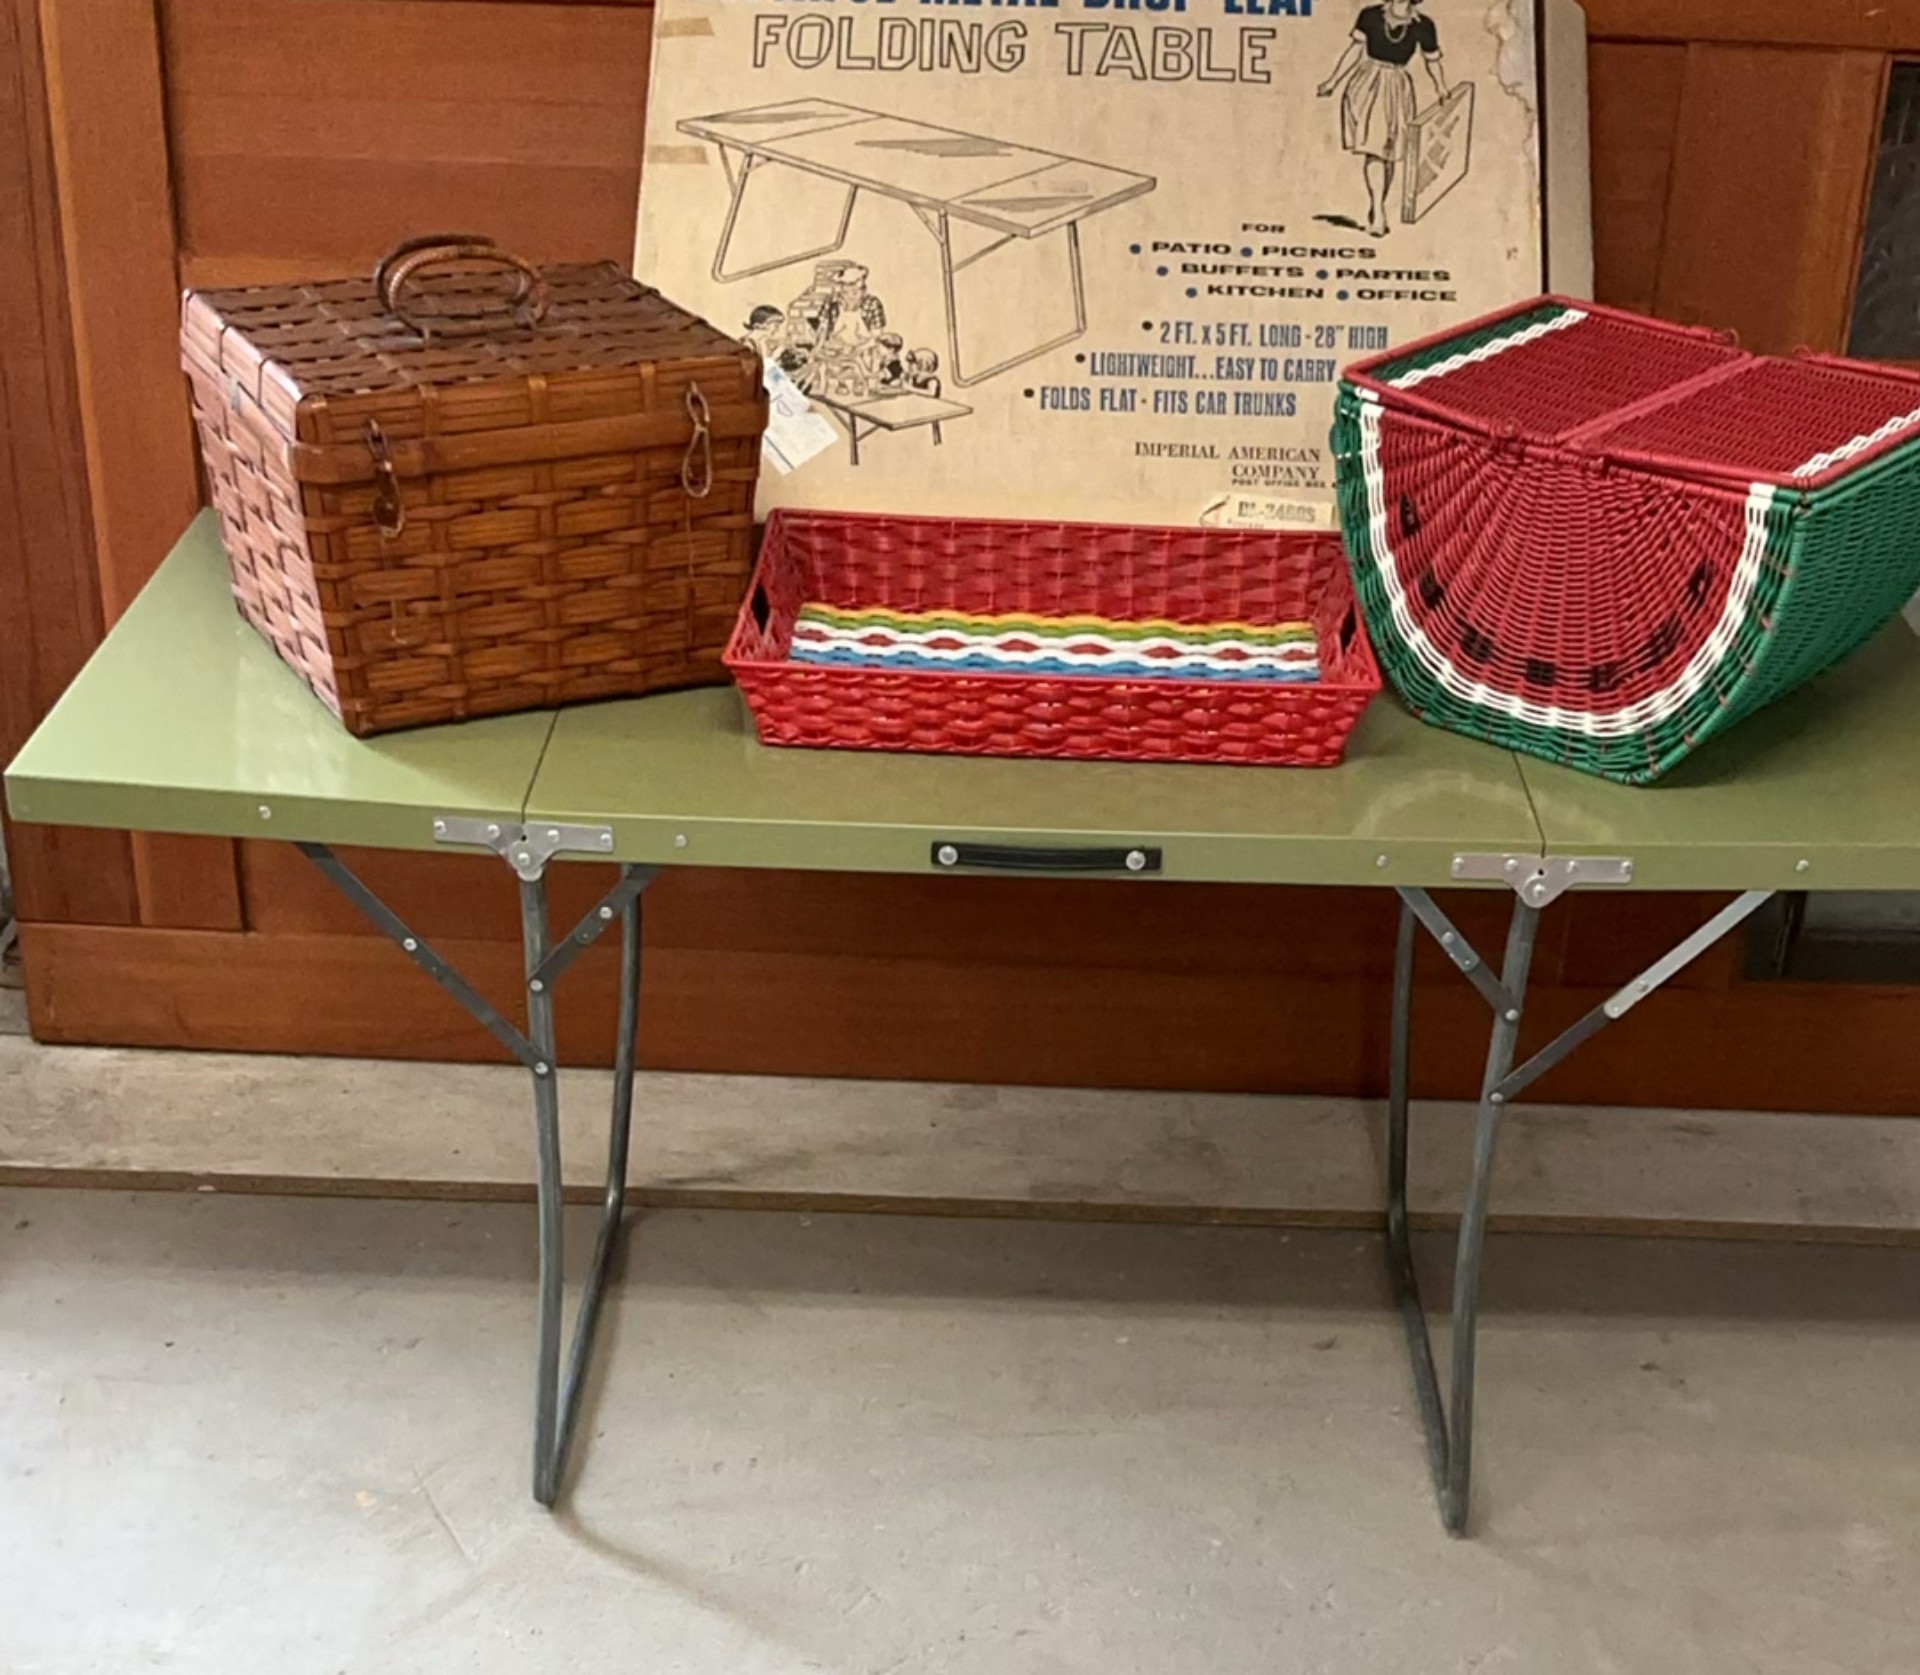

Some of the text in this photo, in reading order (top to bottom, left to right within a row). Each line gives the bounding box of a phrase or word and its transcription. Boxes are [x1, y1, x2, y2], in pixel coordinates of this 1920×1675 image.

[753, 13, 1277, 83] FOLDING TABLE
[1241, 222, 1286, 234] FOR
[1151, 241, 1377, 260] PATIO PICNICS
[1180, 263, 1451, 282] BUFFETS PARTIES
[1206, 284, 1458, 302] KITCHEN OFFICE
[1160, 322, 1171, 344] 2
[1174, 321, 1197, 345] FT.
[1215, 322, 1227, 347] 5
[1229, 323, 1252, 347] FT.
[1259, 324, 1301, 348] LONG
[1348, 326, 1389, 350] HIGH
[1259, 357, 1278, 381] TO
[1283, 358, 1337, 383] CARRY
[1040, 386, 1091, 411] FOLDS
[1100, 387, 1137, 412] FLAT
[1153, 389, 1188, 414] FITS
[1195, 391, 1227, 416] CAR
[1234, 391, 1297, 418] TRUNKS
[1135, 441, 1321, 463] IMPERIAL AMERICAN
[1232, 463, 1320, 480] COMPANY
